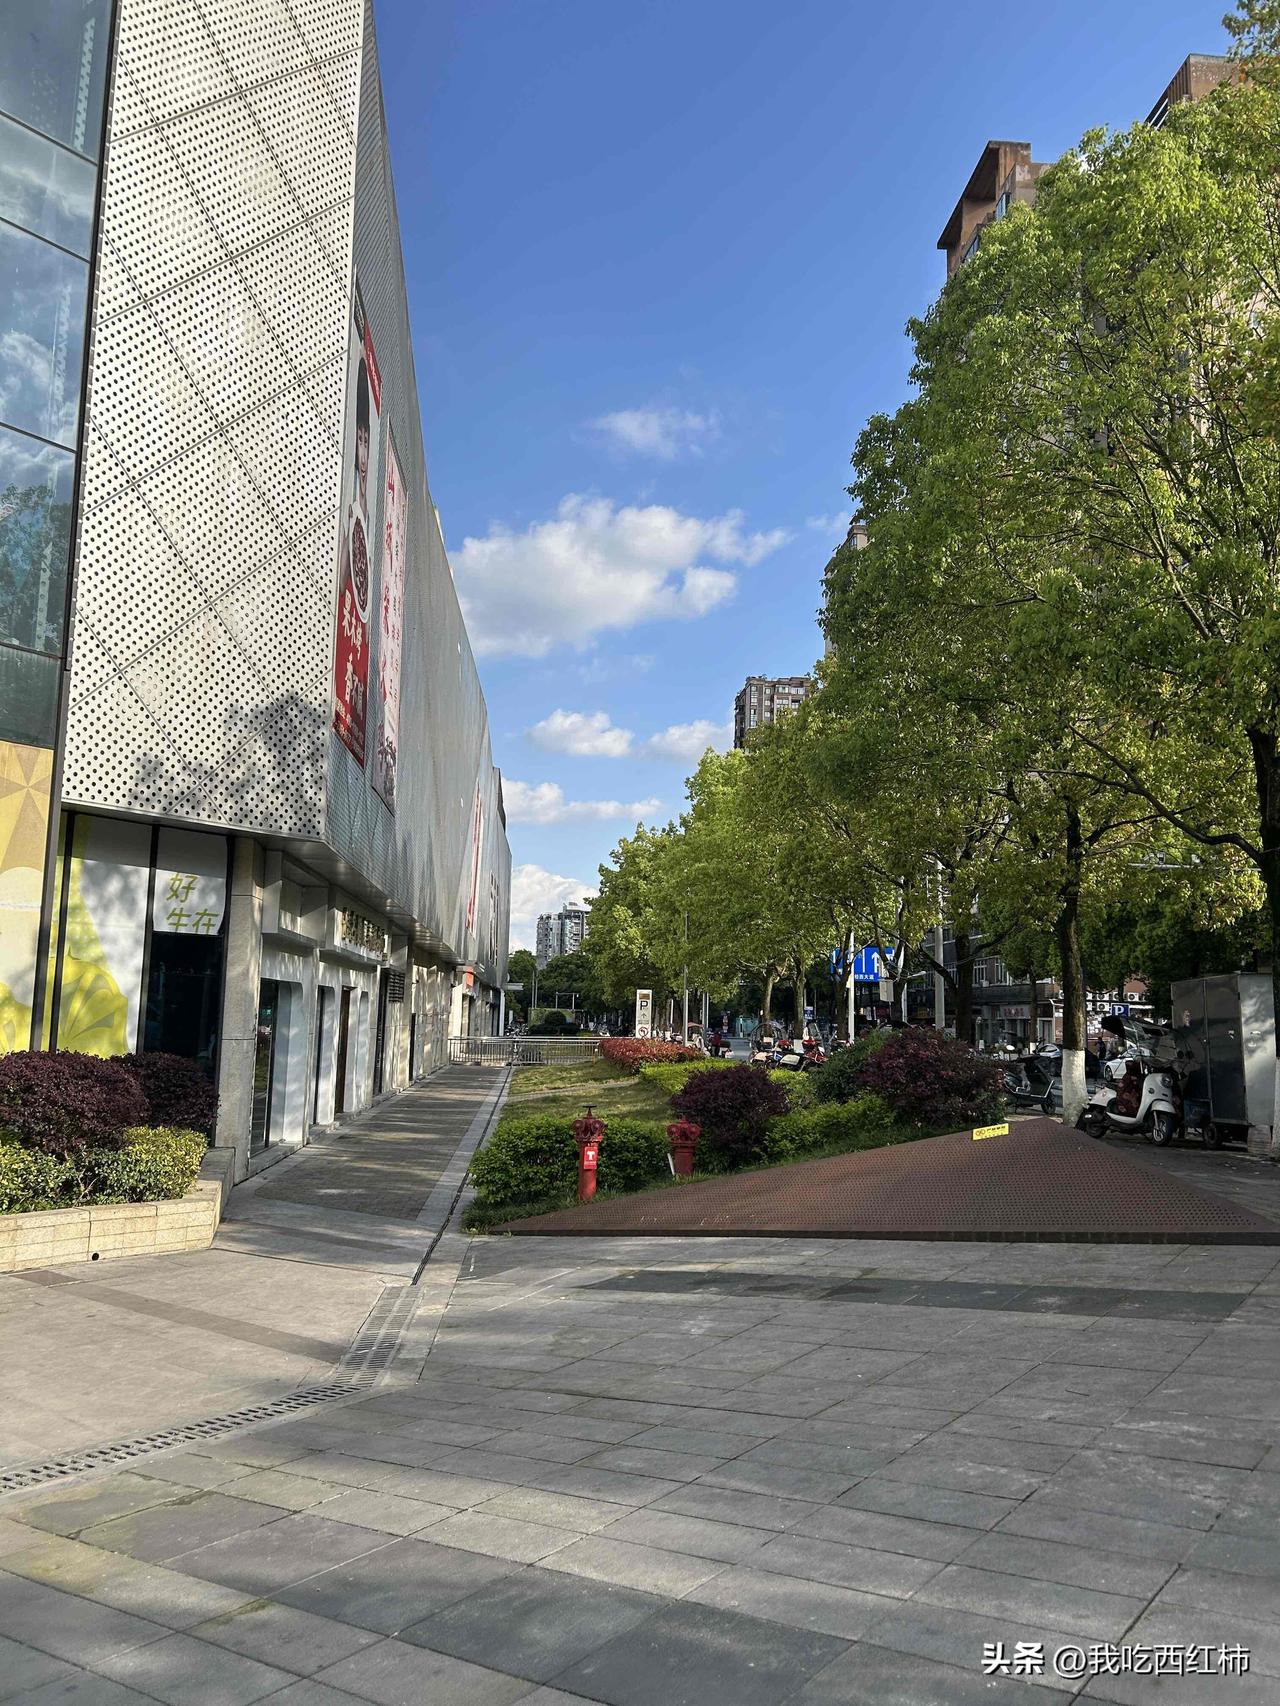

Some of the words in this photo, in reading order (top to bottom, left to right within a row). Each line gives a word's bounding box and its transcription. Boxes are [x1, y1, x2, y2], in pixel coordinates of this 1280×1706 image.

[166, 872, 199, 903] 好
[640, 1000, 649, 1011] P
[1113, 1005, 1124, 1015] P
